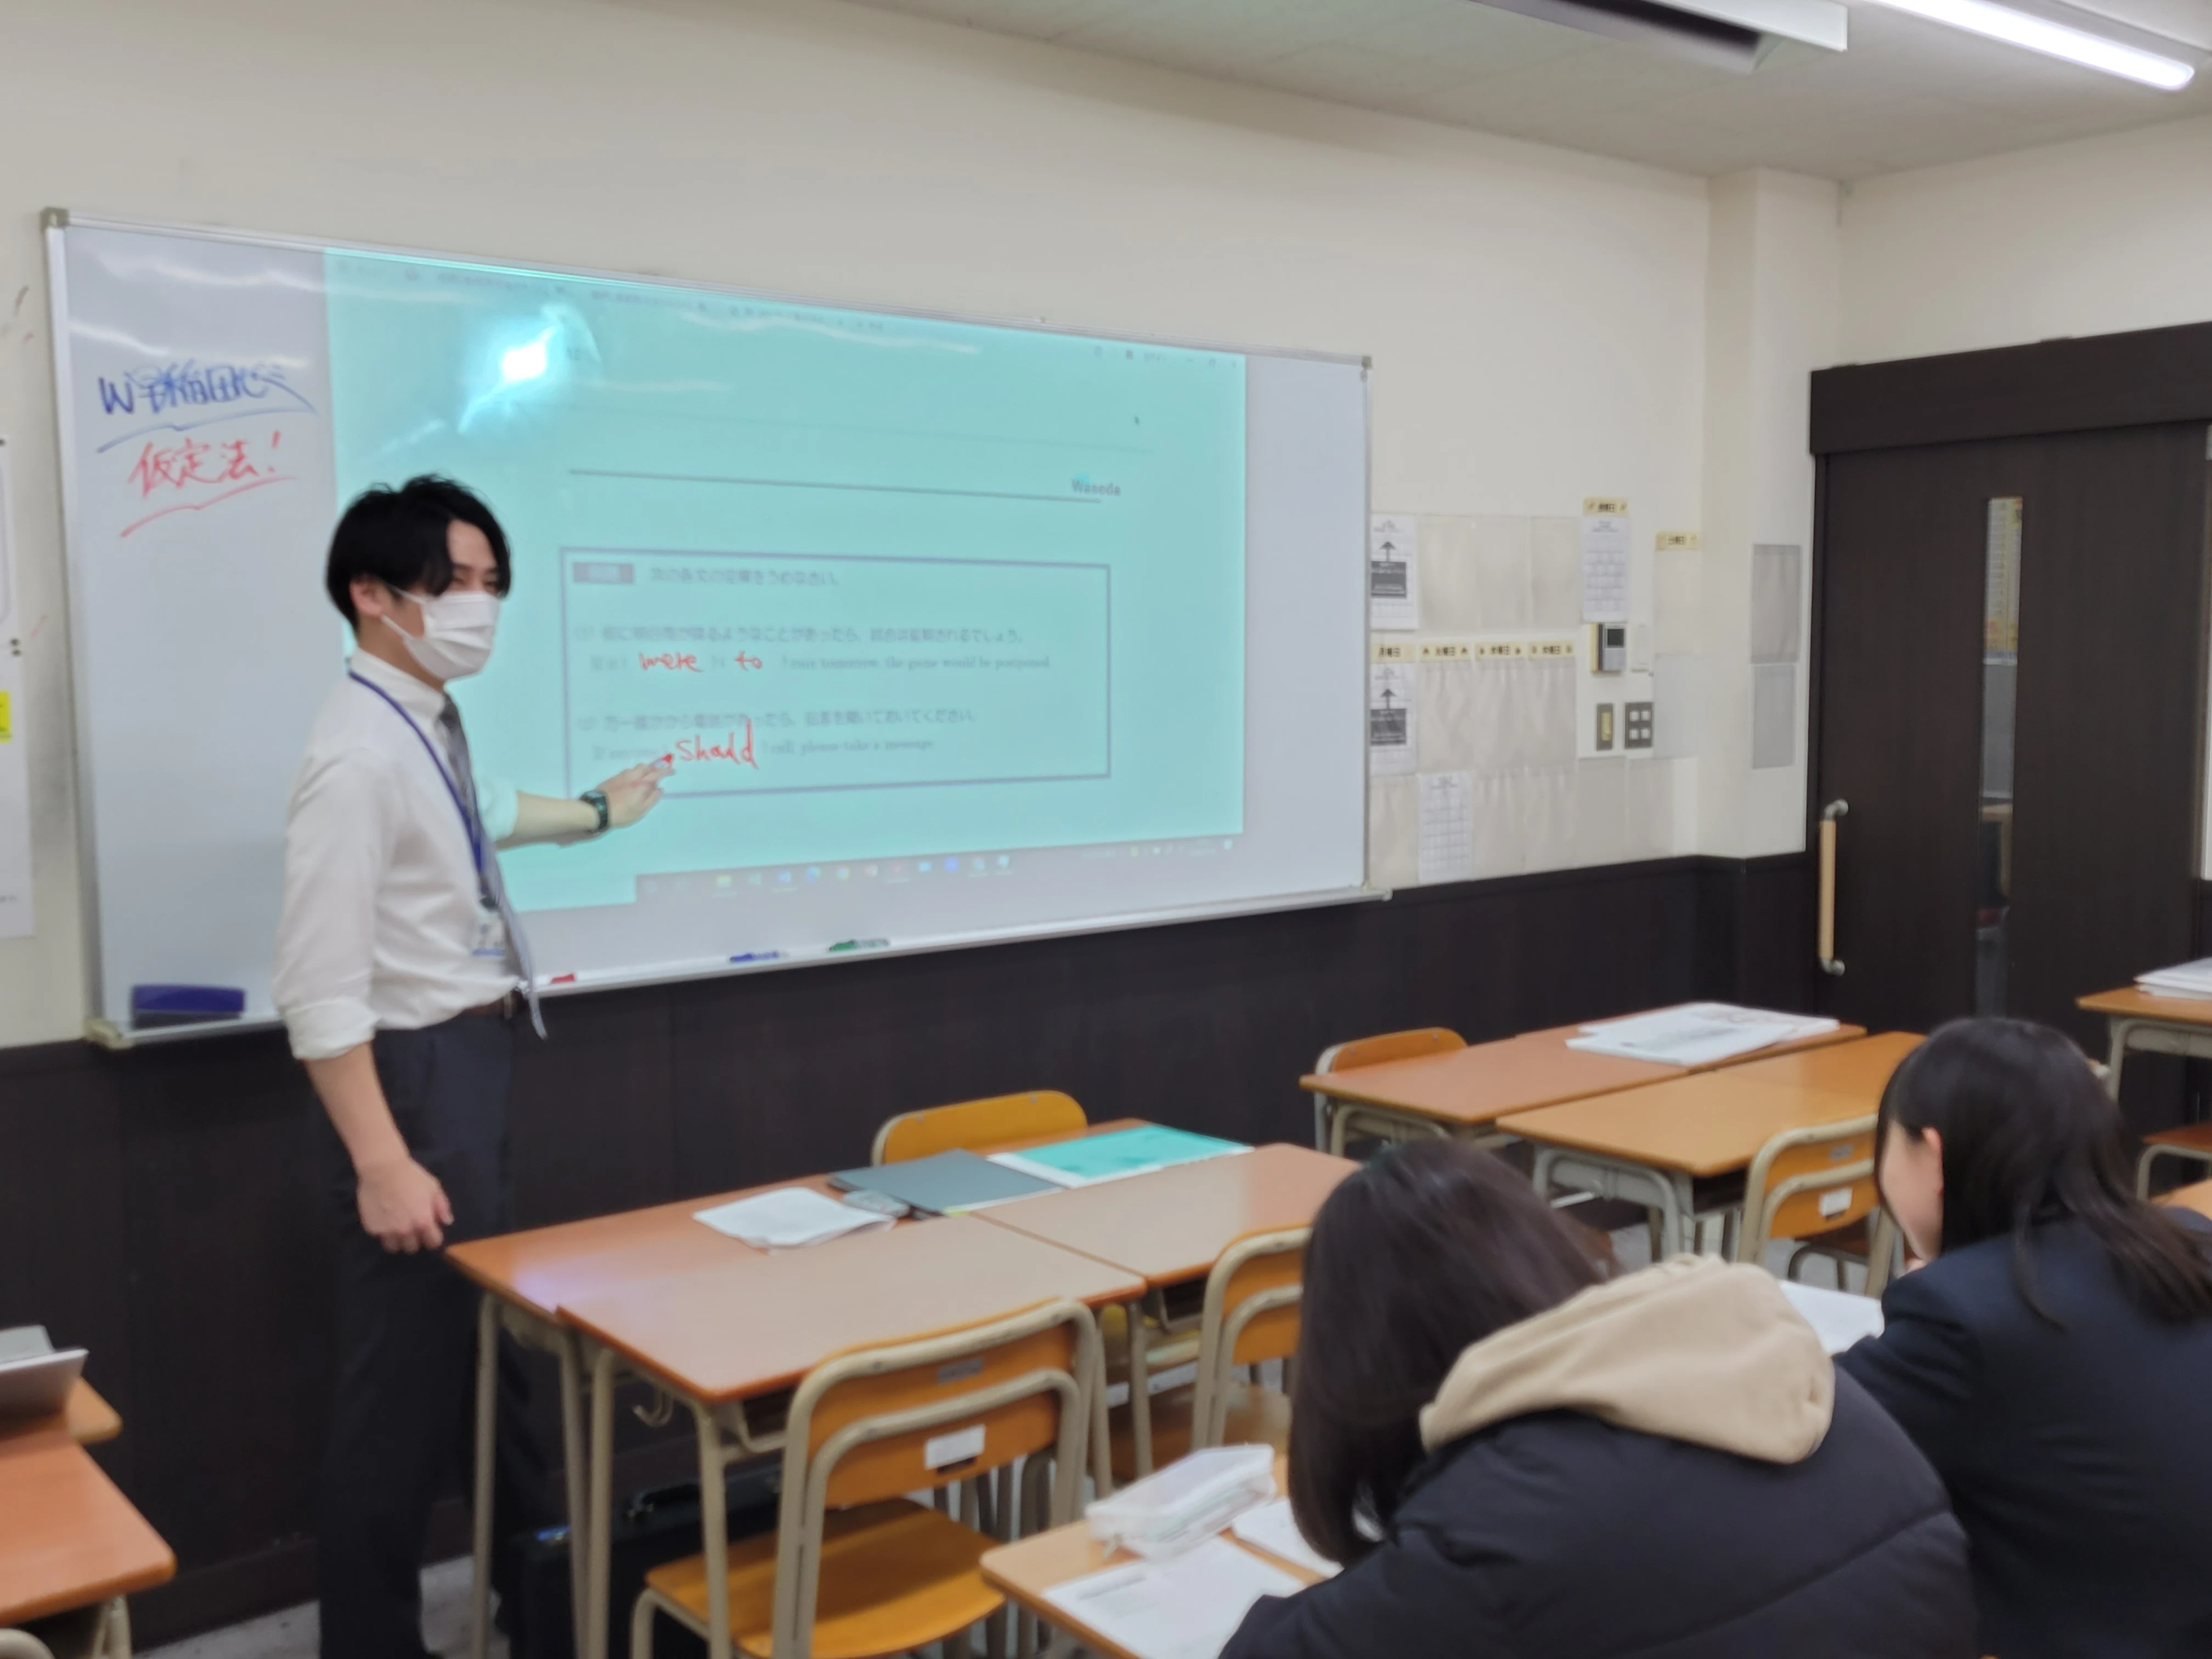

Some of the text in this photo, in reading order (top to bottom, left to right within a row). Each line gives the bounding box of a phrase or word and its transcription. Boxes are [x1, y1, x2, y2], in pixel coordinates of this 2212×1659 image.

[1071, 479, 1121, 496] Waseda
[638, 651, 704, 673] were
[734, 650, 763, 672] to
